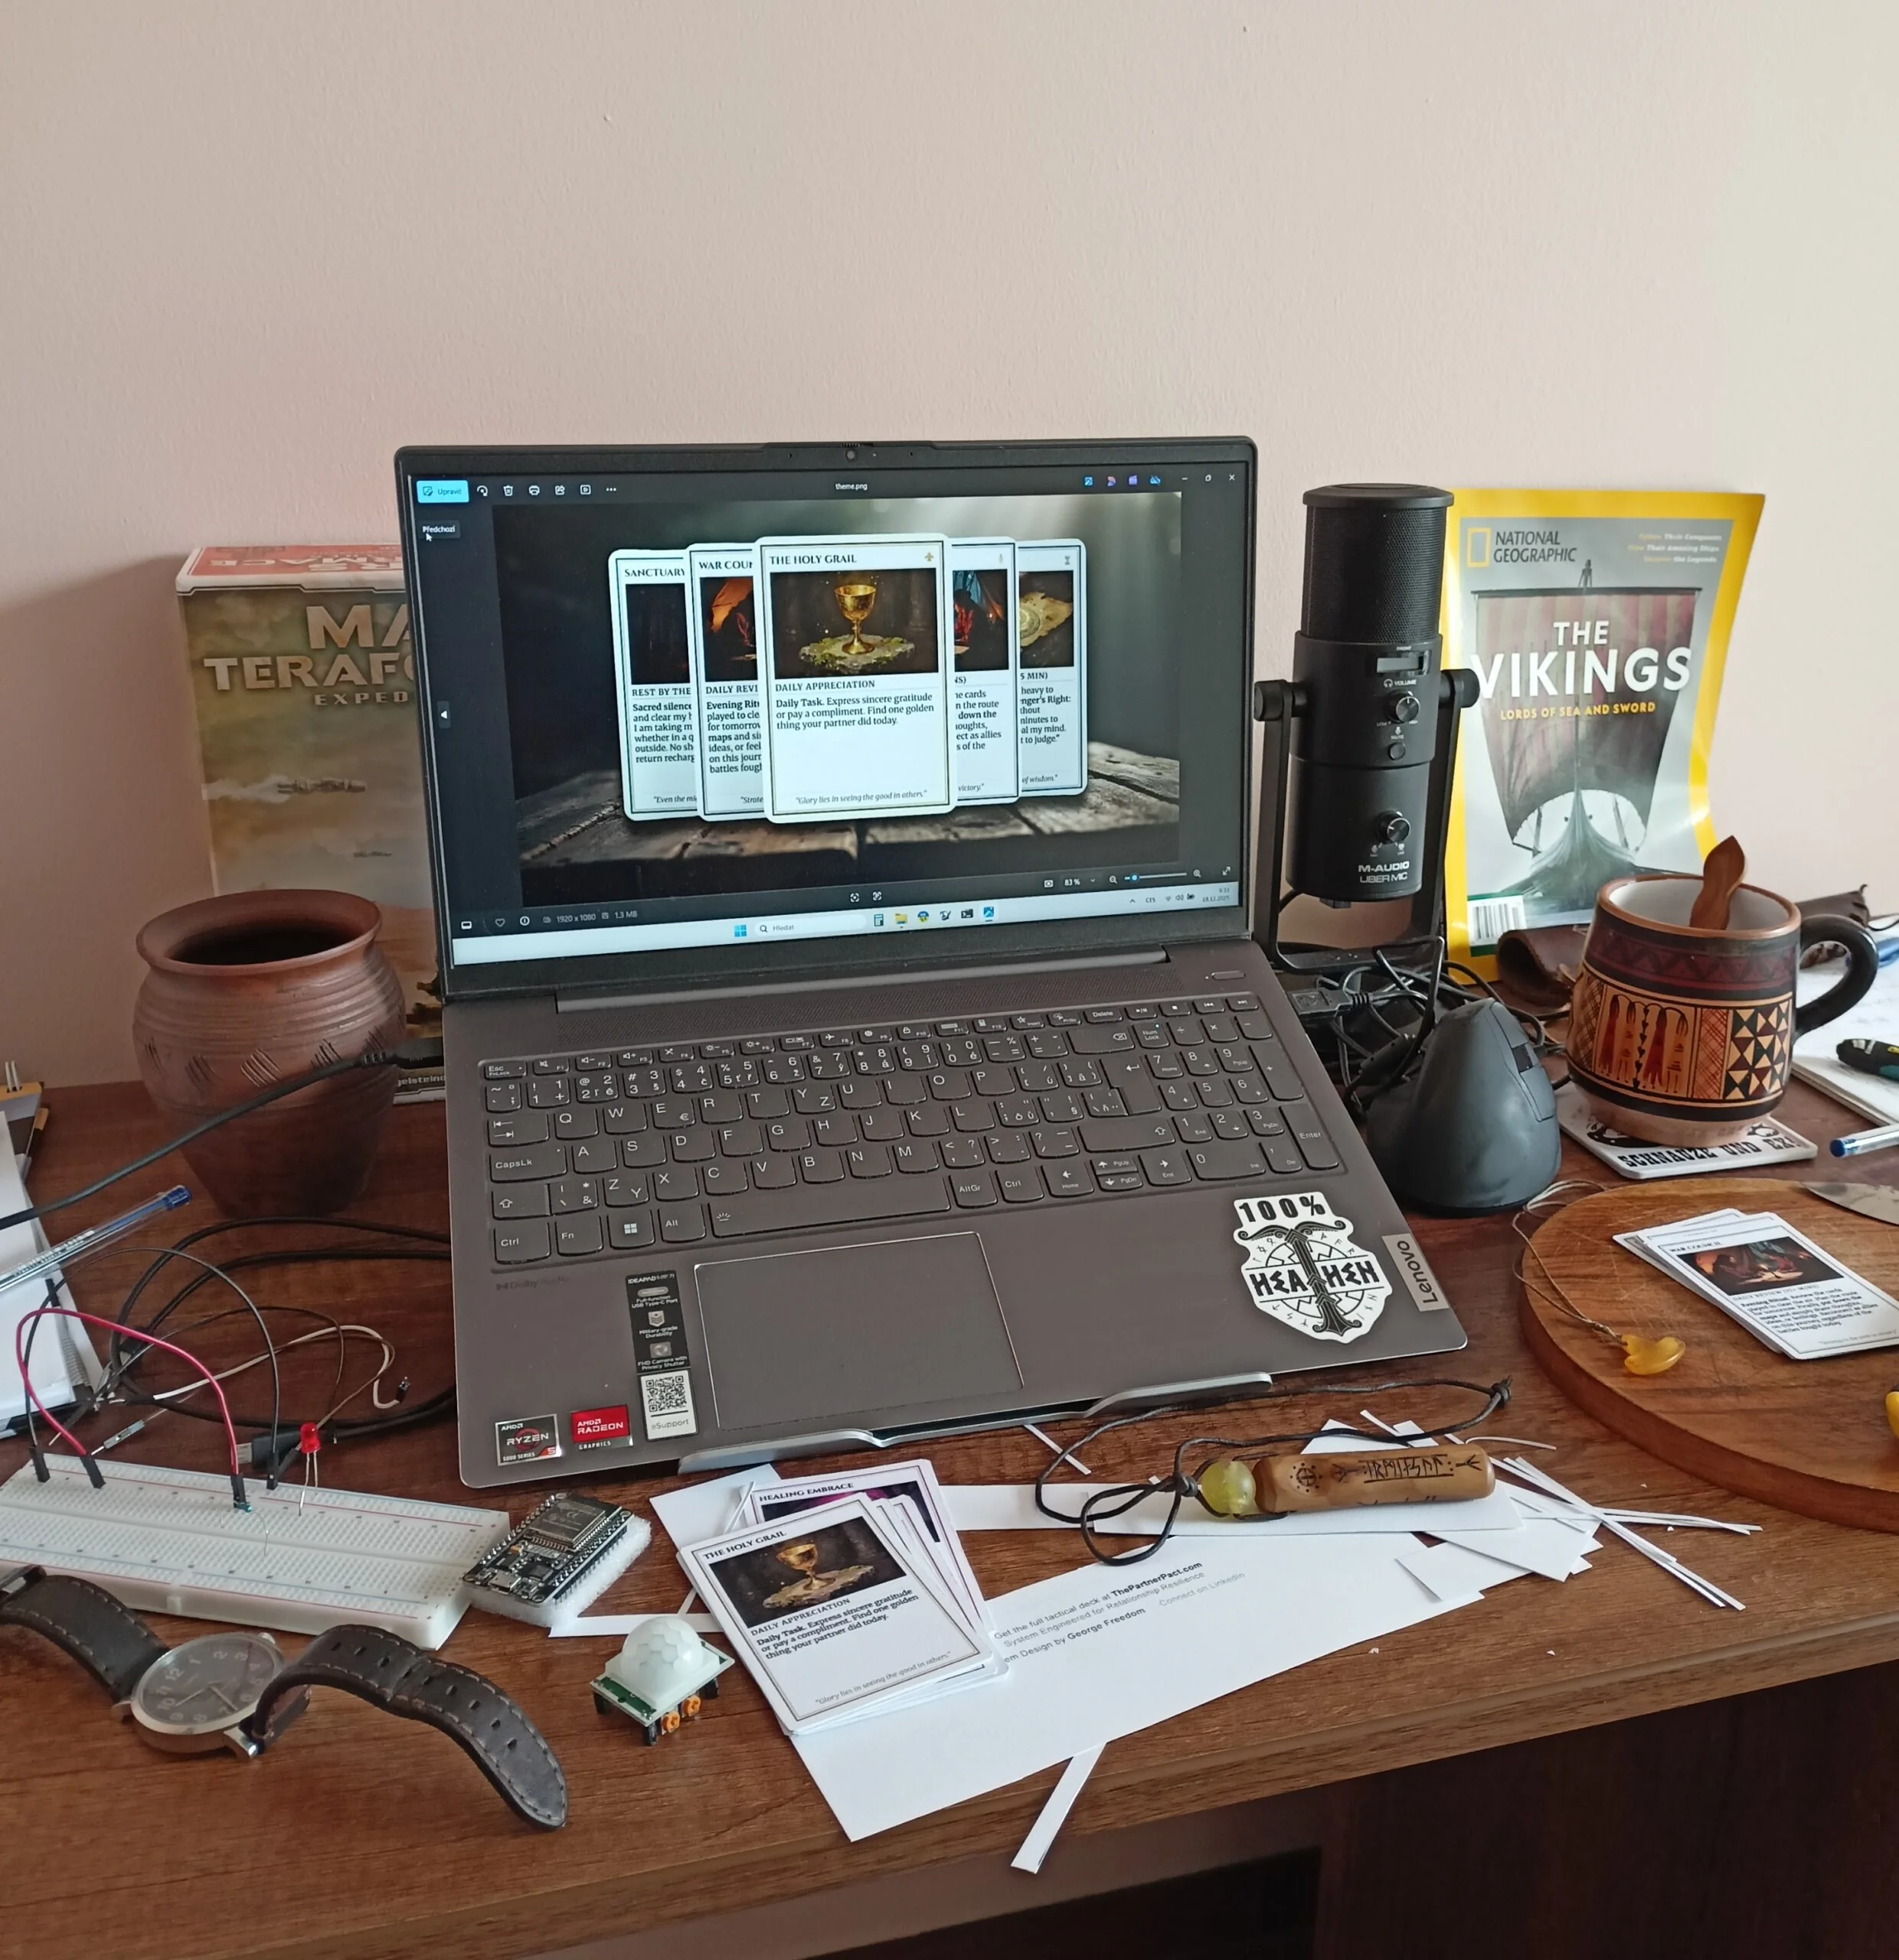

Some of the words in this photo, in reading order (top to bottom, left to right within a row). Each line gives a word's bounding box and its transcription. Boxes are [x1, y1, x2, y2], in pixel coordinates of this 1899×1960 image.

[835, 482, 868, 492] theme.png
[1495, 531, 1561, 545] NATIONAL
[770, 556, 791, 565] THE
[793, 555, 822, 564] HOLY
[825, 554, 857, 564] GRAIL
[1493, 547, 1577, 563] GEOGRAPHIC
[699, 561, 721, 570] WAR
[1553, 621, 1609, 646] THE
[1470, 647, 1691, 699] VIKINGS
[706, 686, 734, 694] DAILY
[775, 683, 803, 692] DAILY
[806, 680, 875, 691] APPRECIATION
[1021, 687, 1044, 695] heavy
[632, 688, 655, 697] REST
[672, 687, 691, 695] THE
[965, 690, 986, 698] cards
[776, 698, 799, 709] Daily
[800, 697, 825, 707] Task.
[826, 697, 861, 707] Express
[862, 695, 892, 704] sincere
[894, 693, 933, 704] gratitude
[978, 700, 999, 708] route
[1048, 695, 1071, 704] Right:
[632, 702, 662, 711] Sacred
[707, 700, 743, 710] Evening
[787, 710, 803, 720] pay
[812, 707, 865, 719] compliment.
[868, 706, 887, 715] Find
[906, 704, 934, 715] golden
[958, 710, 982, 719] down
[1500, 706, 1538, 720] LORDS
[1541, 705, 1556, 718] OF
[1559, 704, 1581, 717] SEA
[1584, 703, 1610, 716] AND
[1613, 701, 1655, 714] SWORD
[707, 711, 734, 722] played
[655, 724, 682, 733] taking
[776, 720, 800, 731] thing
[802, 720, 822, 730] your
[824, 718, 856, 729] partner
[858, 717, 871, 725] did
[873, 717, 898, 727] today.
[635, 734, 669, 743] whether
[708, 733, 732, 743] maps
[980, 730, 1002, 739] allies
[635, 743, 668, 753] outside.
[709, 743, 734, 753] ideas,
[723, 753, 739, 762] this
[710, 764, 739, 773] battles
[840, 794, 861, 803] seeing
[875, 792, 892, 802] good
[1358, 861, 1410, 872] M-AUDIO
[1064, 878, 1073, 887] 83
[557, 914, 573, 923] 1920
[580, 913, 597, 922] 1080
[773, 923, 795, 933] Hledat
[750, 1093, 761, 1102] T
[704, 1098, 715, 1108] R
[559, 1113, 572, 1123] Q
[608, 1107, 624, 1119] W
[1299, 1131, 1322, 1139] Enter
[578, 1147, 590, 1156] A
[627, 1142, 638, 1151] S
[1721, 1142, 1762, 1155] UND
[495, 1159, 533, 1169] CapsLk
[959, 1184, 981, 1193] AltGr
[1005, 1180, 1021, 1188] Ctrl
[1238, 1195, 1325, 1223] 100%
[665, 1219, 678, 1227] Alt
[501, 1238, 519, 1246] Ctrl
[1397, 1240, 1439, 1304] Lenovo
[577, 1422, 623, 1434] RADEON
[651, 1419, 689, 1430] eSupport
[506, 1432, 549, 1446] RYZEN
[579, 1441, 611, 1450] GRAPHICS
[759, 1490, 805, 1502] HEALING
[807, 1482, 855, 1495] EMBRACE
[703, 1549, 725, 1560] THE
[727, 1540, 754, 1553] HOLY
[755, 1531, 787, 1544] GRAIL
[994, 1630, 1012, 1639] Get
[1013, 1624, 1028, 1633] the
[1028, 1618, 1044, 1627] full
[1044, 1606, 1077, 1622] tactical
[1078, 1598, 1100, 1609] deck
[1111, 1561, 1203, 1598] ThePartnerPact.com
[1159, 1589, 1197, 1606] Connect
[750, 1622, 780, 1636] DAILY
[782, 1598, 851, 1625] APPRECIATION
[757, 1632, 781, 1646] Daily
[782, 1625, 806, 1637] Task.
[808, 1614, 842, 1628] Express
[842, 1602, 874, 1615] sincere
[874, 1589, 913, 1607] gratitude
[1004, 1632, 1039, 1647] System
[1040, 1612, 1091, 1635] Engineered
[1106, 1587, 1160, 1611] Relationship
[773, 1639, 789, 1650] pay
[797, 1619, 851, 1642] compliment.
[853, 1610, 873, 1622] Find
[891, 1595, 919, 1610] golden
[766, 1648, 792, 1660] thing
[792, 1638, 812, 1652] your
[814, 1628, 846, 1645] partner
[863, 1614, 889, 1627] today.
[1020, 1642, 1054, 1657] Design
[1067, 1623, 1103, 1640] George
[1103, 1607, 1146, 1627] Freedom
[862, 1677, 886, 1689] seeing
[899, 1664, 917, 1676] good
